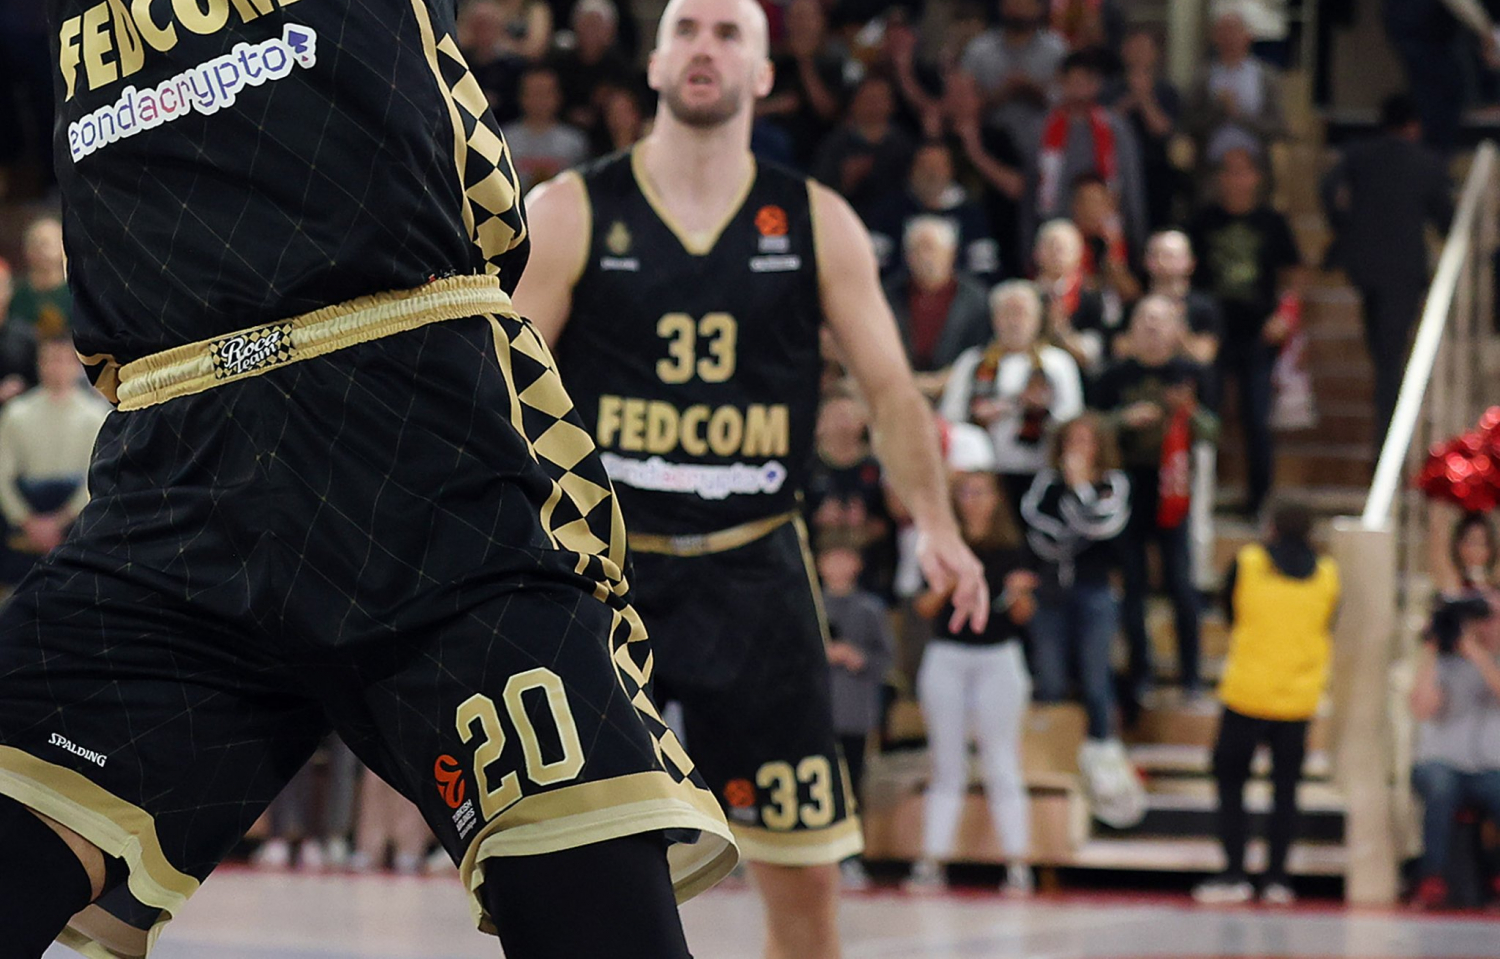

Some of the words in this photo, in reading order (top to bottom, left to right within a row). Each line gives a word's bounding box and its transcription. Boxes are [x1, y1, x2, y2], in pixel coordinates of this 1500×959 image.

[221, 331, 280, 368] Roca
[656, 311, 739, 384] 33
[597, 395, 790, 457] FEDCOM
[48, 732, 107, 767] SPALDING
[456, 667, 585, 822] 20
[756, 755, 835, 832] 33
